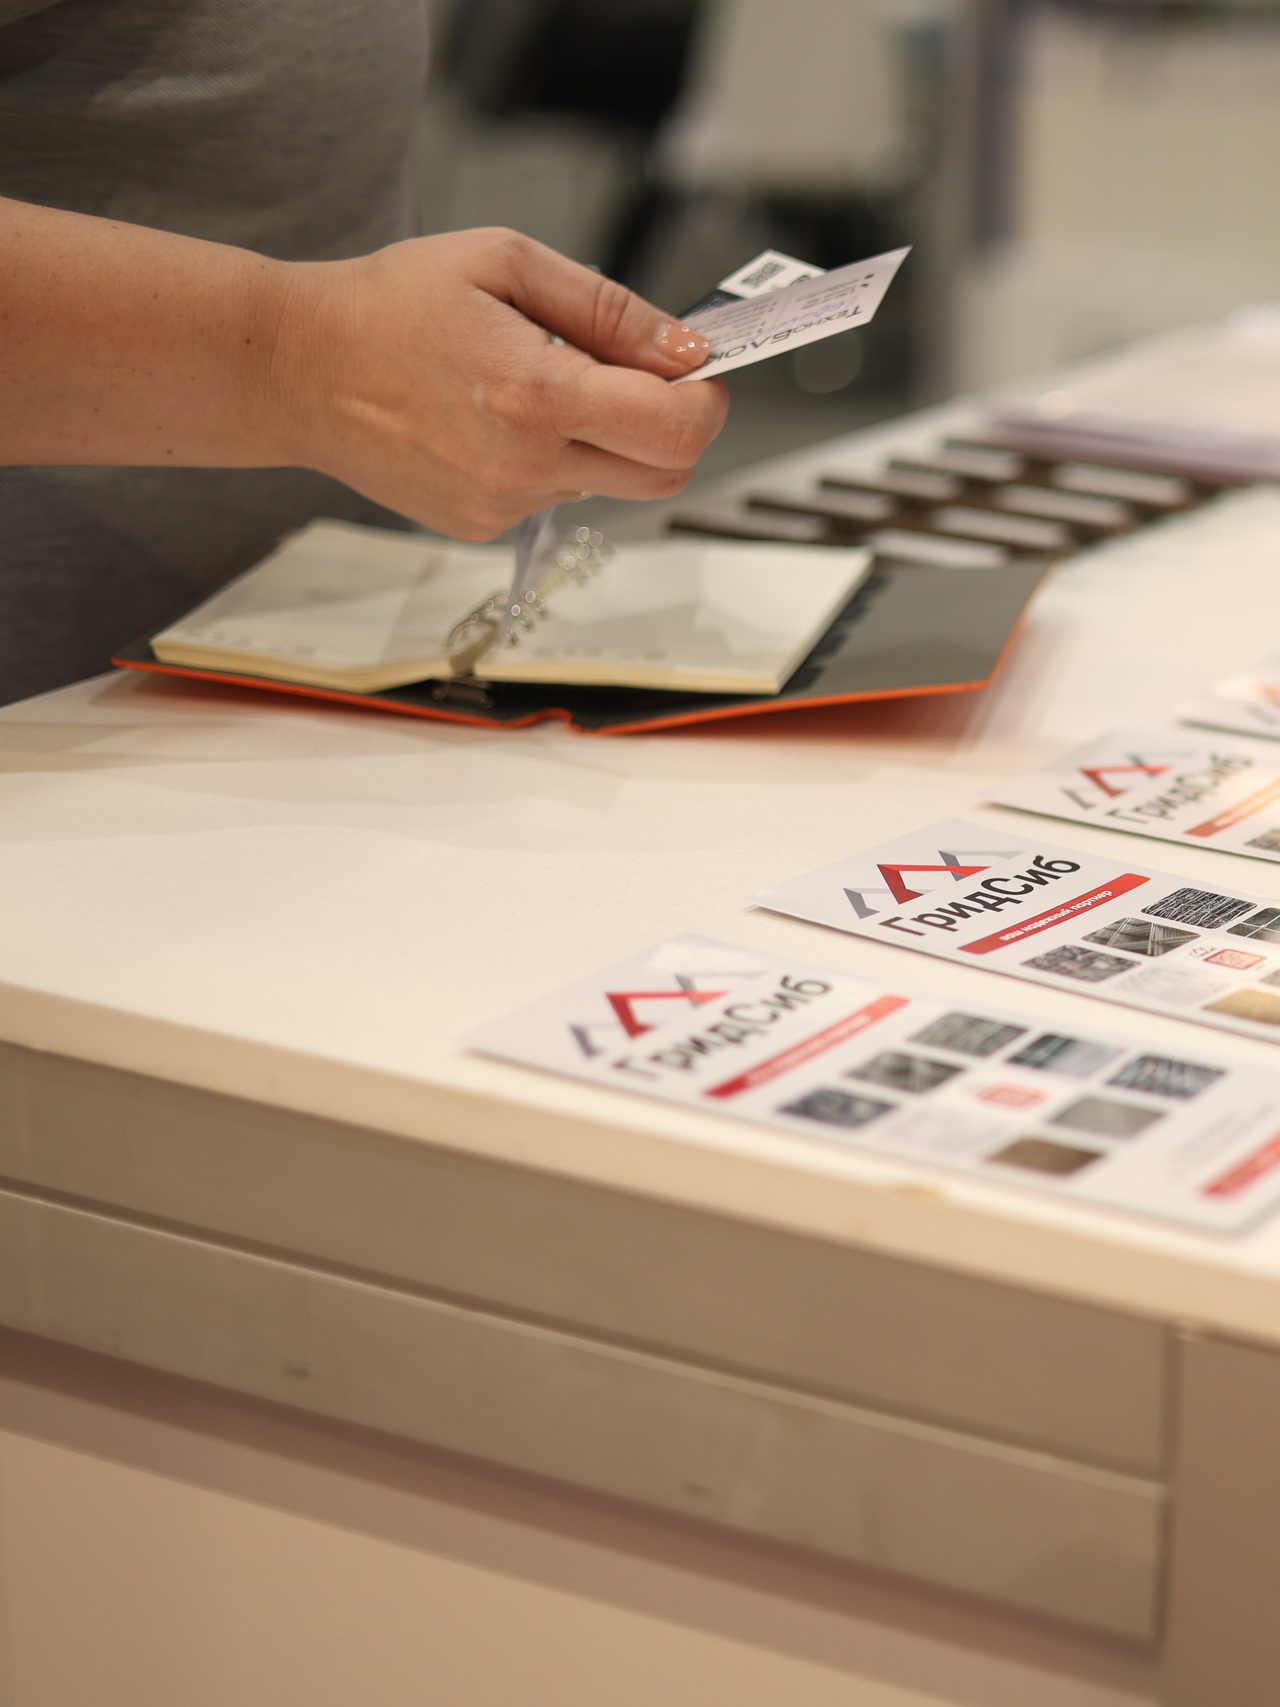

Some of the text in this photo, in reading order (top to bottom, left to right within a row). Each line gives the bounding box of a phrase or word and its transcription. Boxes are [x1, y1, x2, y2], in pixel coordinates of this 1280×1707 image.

[878, 855, 1081, 936] ГридСиб
[1070, 890, 1112, 910] партнер
[610, 974, 833, 1082] ГридСиб
